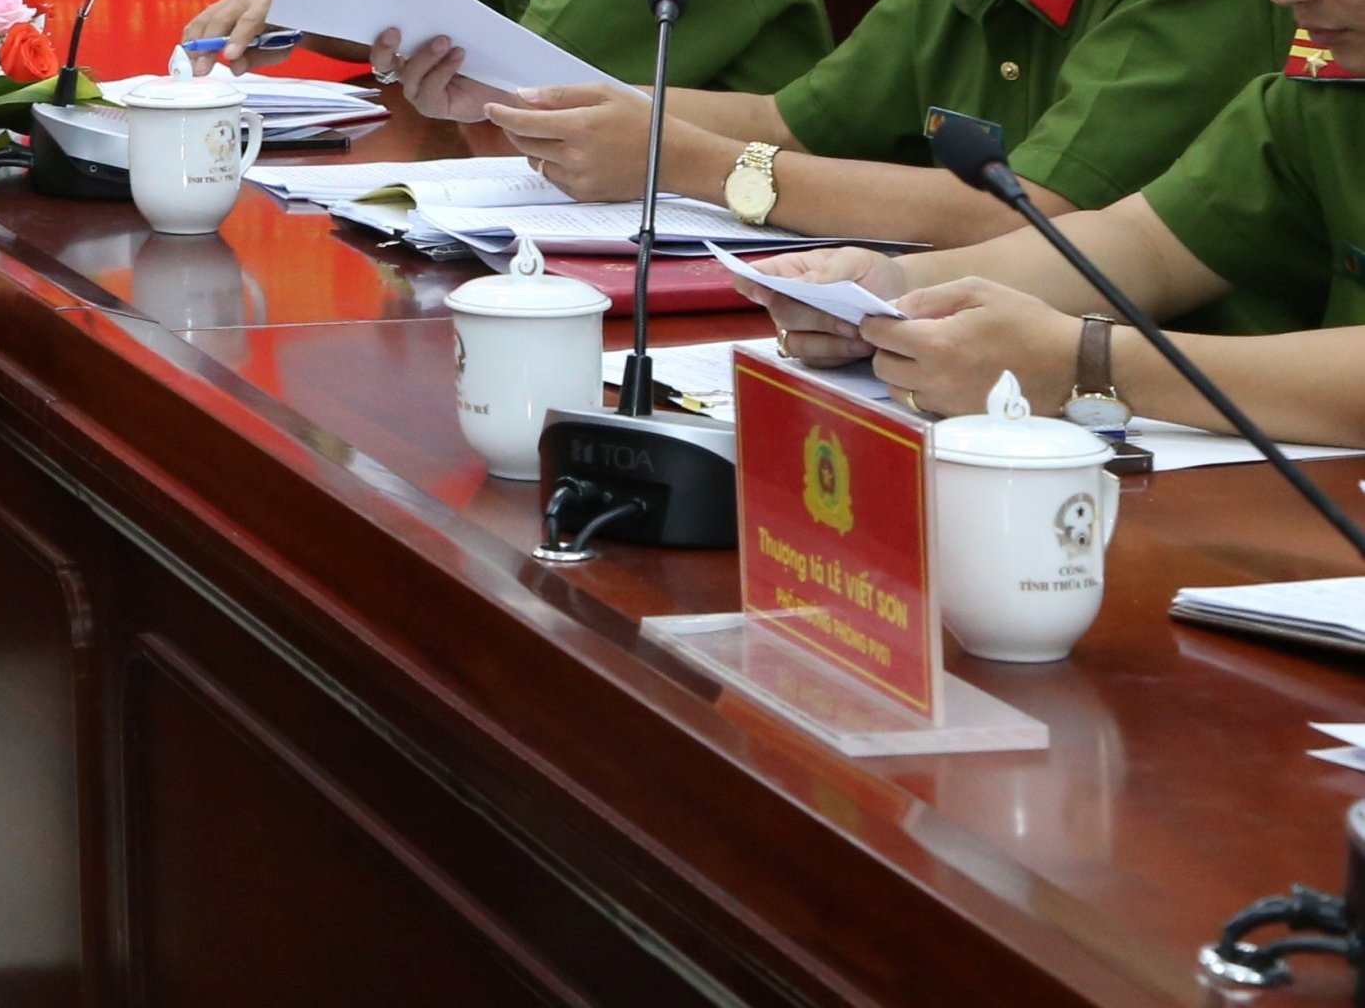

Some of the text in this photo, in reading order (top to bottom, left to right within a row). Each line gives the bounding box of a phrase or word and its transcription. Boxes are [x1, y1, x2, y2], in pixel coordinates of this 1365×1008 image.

[602, 442, 656, 474] TOA
[758, 525, 909, 630] Thượng tá LÊ VIẾT SƠN
